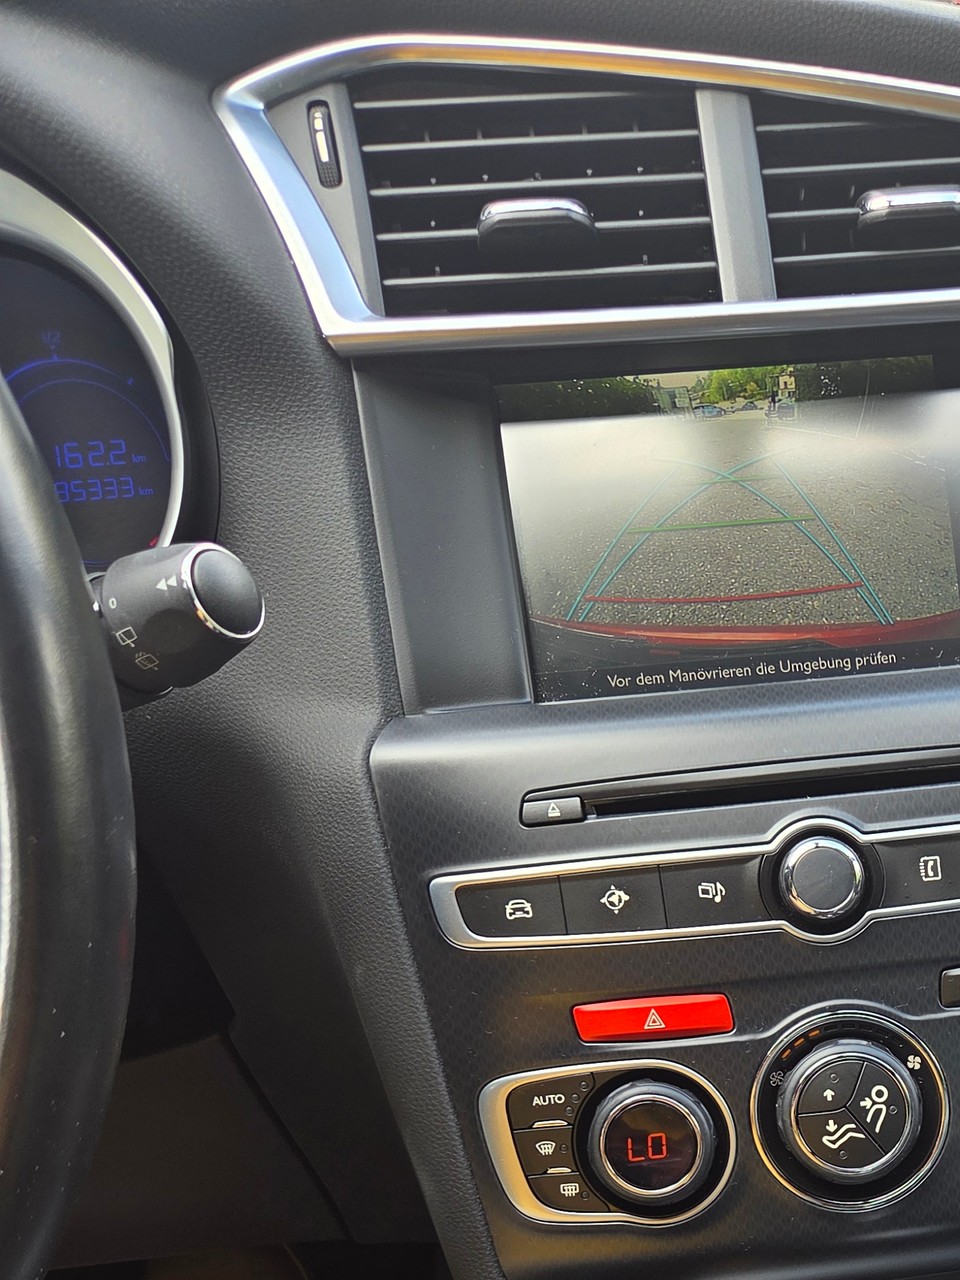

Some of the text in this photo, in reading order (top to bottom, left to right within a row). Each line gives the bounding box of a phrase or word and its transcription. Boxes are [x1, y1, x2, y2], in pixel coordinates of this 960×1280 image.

[132, 454, 147, 463] km
[139, 487, 154, 495] km
[607, 652, 897, 688] Vor dem Manövrieren die Umgebung prüfen
[532, 1094, 565, 1106] AUTO
